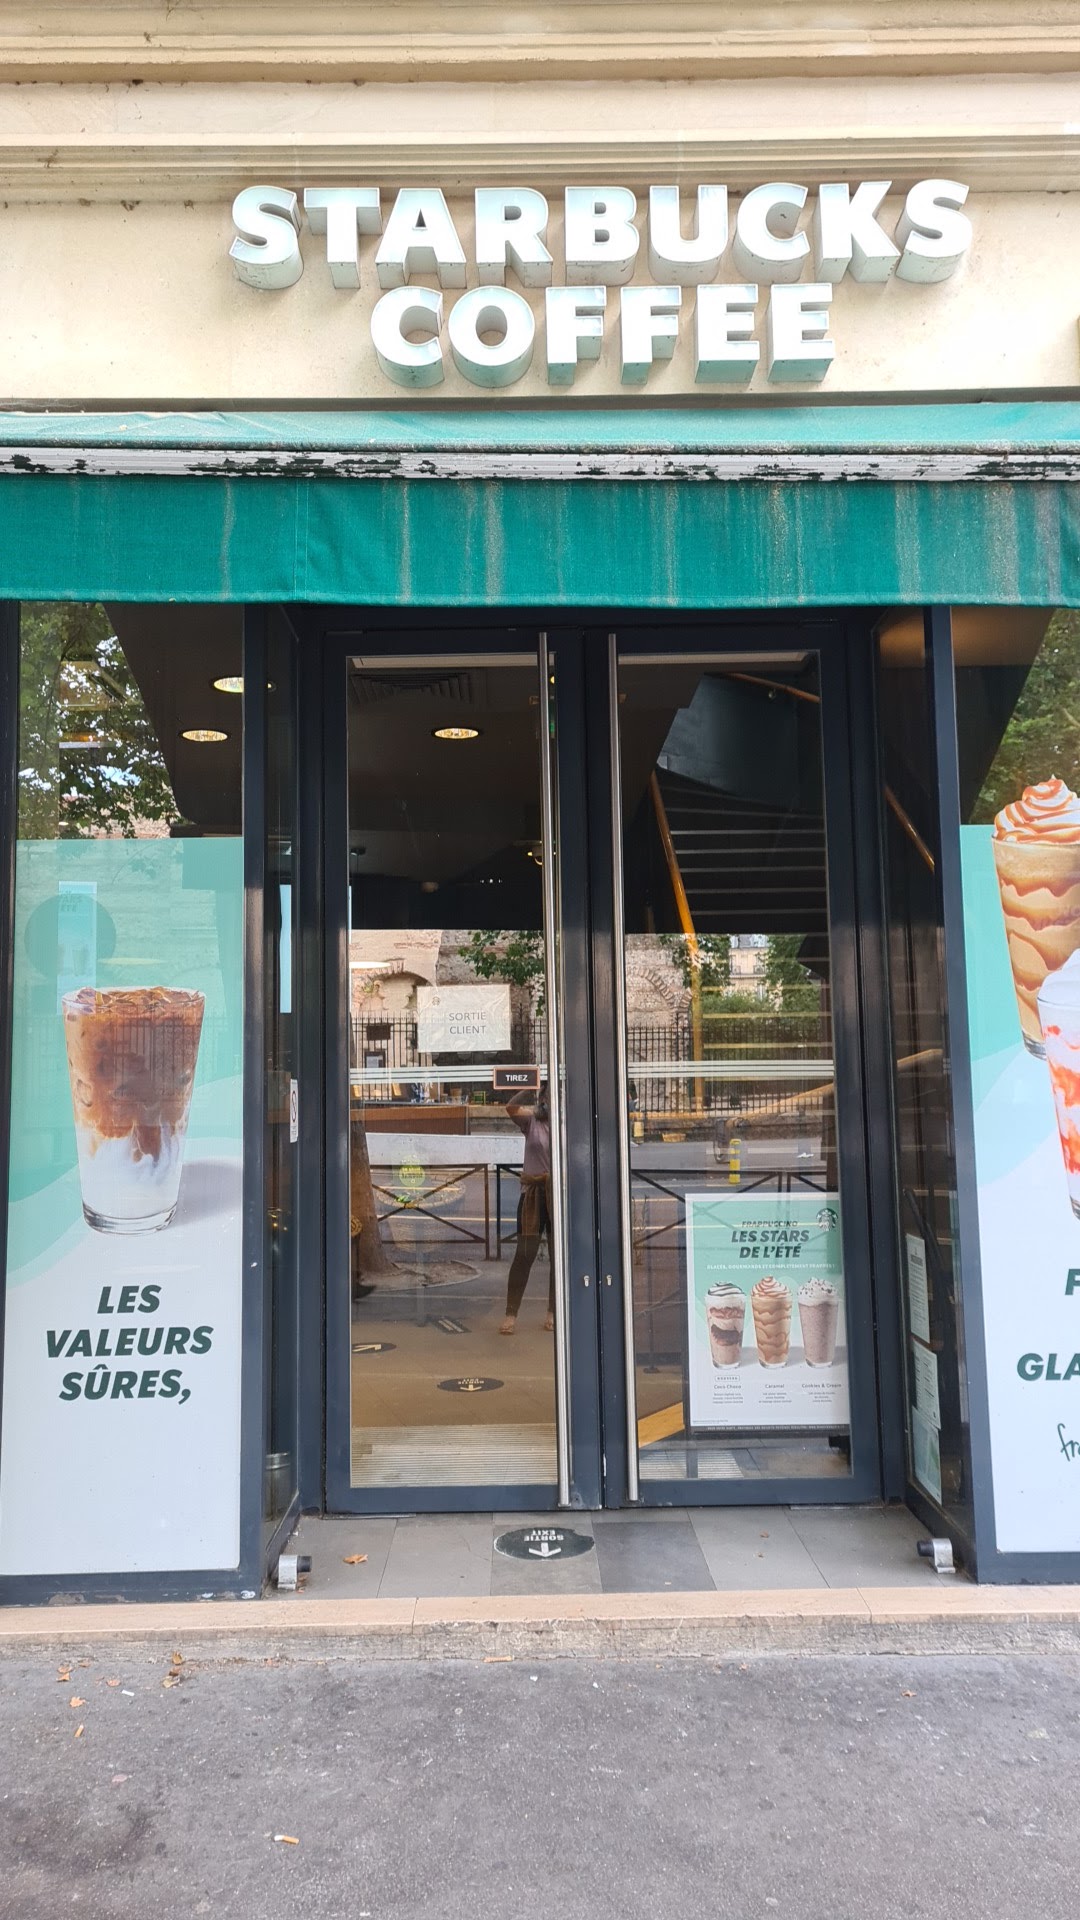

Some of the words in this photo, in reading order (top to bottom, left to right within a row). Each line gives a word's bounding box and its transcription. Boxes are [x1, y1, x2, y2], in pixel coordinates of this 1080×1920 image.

[229, 179, 974, 270] STARBUCKS
[370, 282, 834, 374] COFFEE
[449, 1012, 486, 1022] SORTIE
[449, 1025, 486, 1035] CLIENT
[505, 1074, 528, 1082] TIREZ
[731, 1230, 758, 1243] LES
[760, 1229, 810, 1243] STARS
[739, 1246, 760, 1258] DE
[763, 1242, 802, 1258] L'ÉTÉ
[97, 1284, 162, 1314] LES
[46, 1325, 214, 1358] VALEURS
[59, 1363, 192, 1405] SÛRES,
[1057, 1423, 1080, 1462] fr
